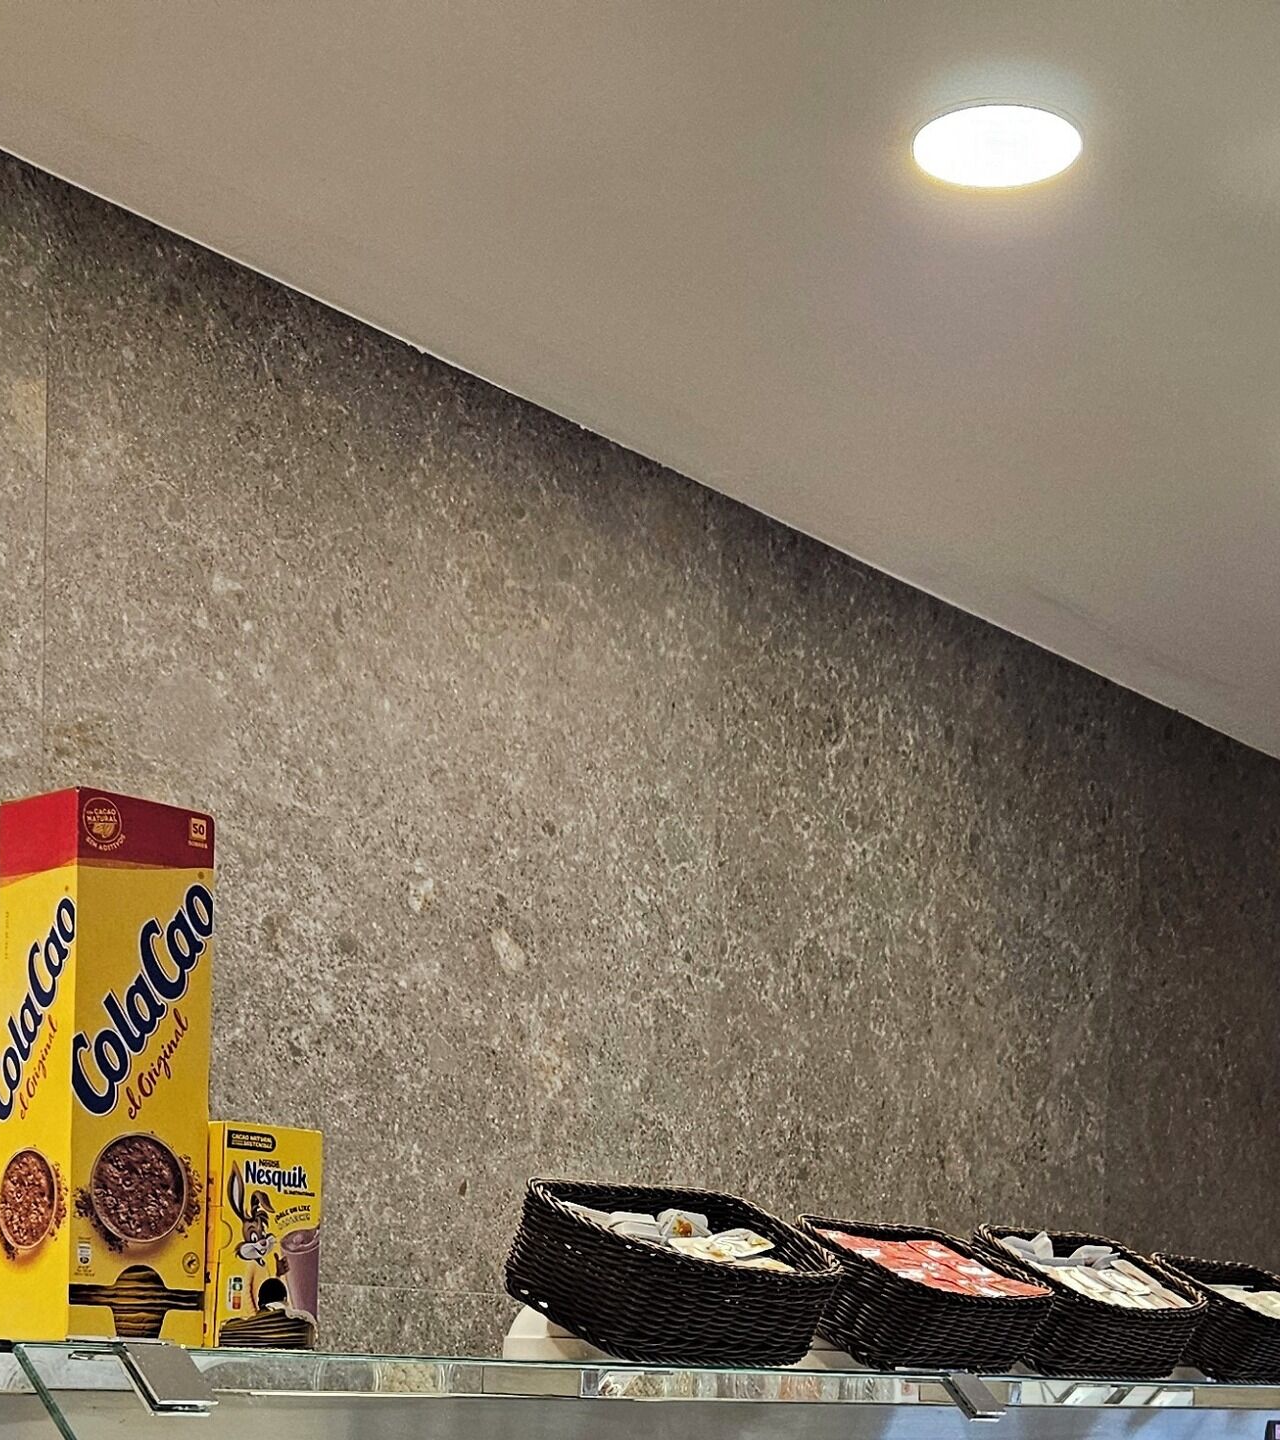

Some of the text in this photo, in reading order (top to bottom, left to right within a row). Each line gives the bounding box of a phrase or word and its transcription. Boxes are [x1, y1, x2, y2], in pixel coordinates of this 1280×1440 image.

[86, 815, 118, 823] NATURAL
[93, 808, 116, 816] CACAO
[192, 823, 205, 836] 50
[71, 883, 214, 1117] ColaCao
[137, 1007, 189, 1099] Original
[244, 1159, 308, 1193] Nesquik
